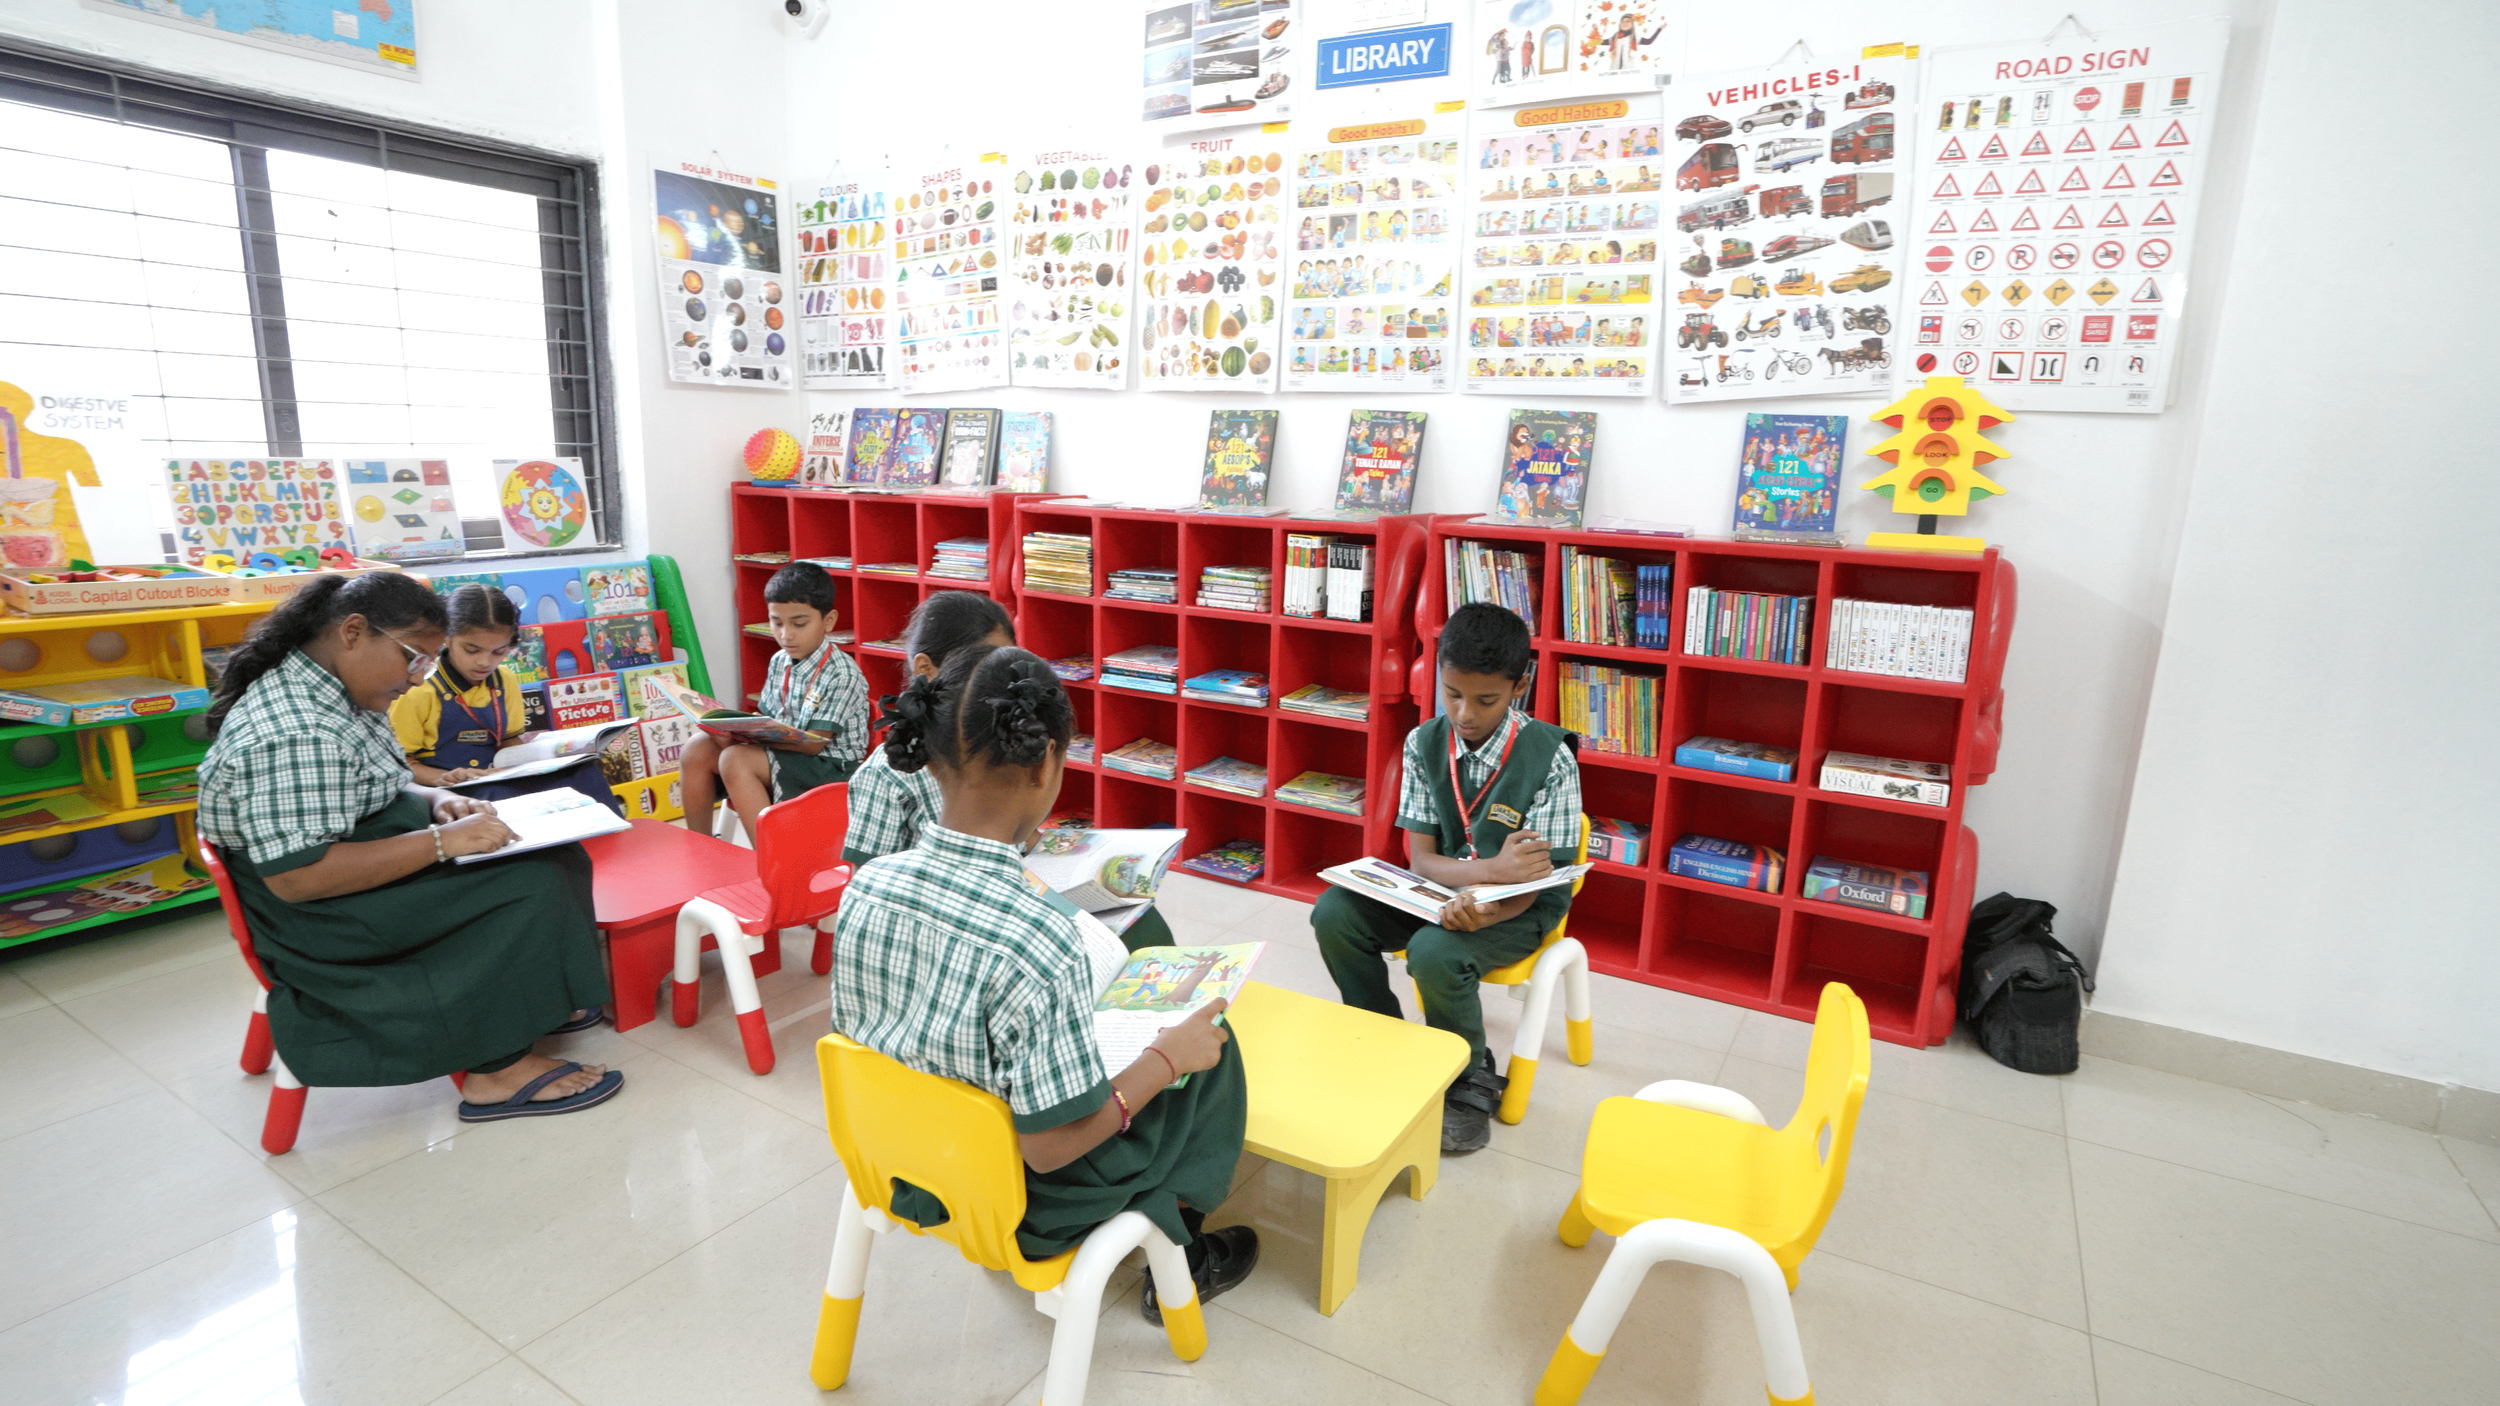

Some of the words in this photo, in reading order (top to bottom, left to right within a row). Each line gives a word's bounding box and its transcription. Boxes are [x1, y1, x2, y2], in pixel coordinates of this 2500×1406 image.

[1332, 37, 1435, 76] LIBRARY
[1995, 56, 2073, 80] ROAD
[2080, 47, 2151, 73] SIGN
[1707, 64, 1860, 108] VEHICLES-I
[2074, 94, 2101, 104] STOP
[1521, 108, 1559, 126] Good
[1562, 104, 1609, 121] Habits
[1613, 103, 1623, 117] 2
[1338, 128, 1368, 141] Good
[1371, 124, 1407, 138] Habits
[1190, 138, 1234, 154] FRUIT
[681, 162, 713, 178] SOLAR
[716, 170, 754, 186] SYSTEM
[921, 168, 963, 189] SHAPES
[818, 183, 859, 198] COLOURS
[1974, 250, 1986, 266] P
[43, 413, 124, 430] SYSTEM
[812, 435, 842, 447] UNIVERSE
[1231, 443, 1246, 454] 121
[1222, 454, 1251, 466] AESOP'S
[1372, 446, 1389, 459] 121
[1537, 448, 1556, 461] 121
[1355, 458, 1377, 469] TENALI
[1378, 459, 1402, 470] RAMAN
[1527, 461, 1562, 475] JATAKA
[1778, 460, 1799, 474] 121
[1771, 486, 1801, 497] Stories
[80, 589, 132, 605] Capital
[136, 587, 184, 602] Cutout
[187, 585, 230, 599] Blocks
[603, 583, 637, 600] 101
[50, 597, 79, 605] LOGIC
[1908, 627, 1919, 673] OCCUPATIONS
[1916, 635, 1928, 674] NUMBERS
[560, 699, 572, 707] My
[572, 694, 607, 705] Ultimate
[652, 701, 673, 711] world
[558, 704, 611, 722] Picture
[628, 728, 644, 775] WORLD
[1825, 769, 1877, 782] ULTIMATE
[1825, 775, 1877, 792] VISUAL
[1927, 787, 1941, 803] DK
[1698, 867, 1739, 883] Dictionary
[1840, 885, 1886, 903] Oxford
